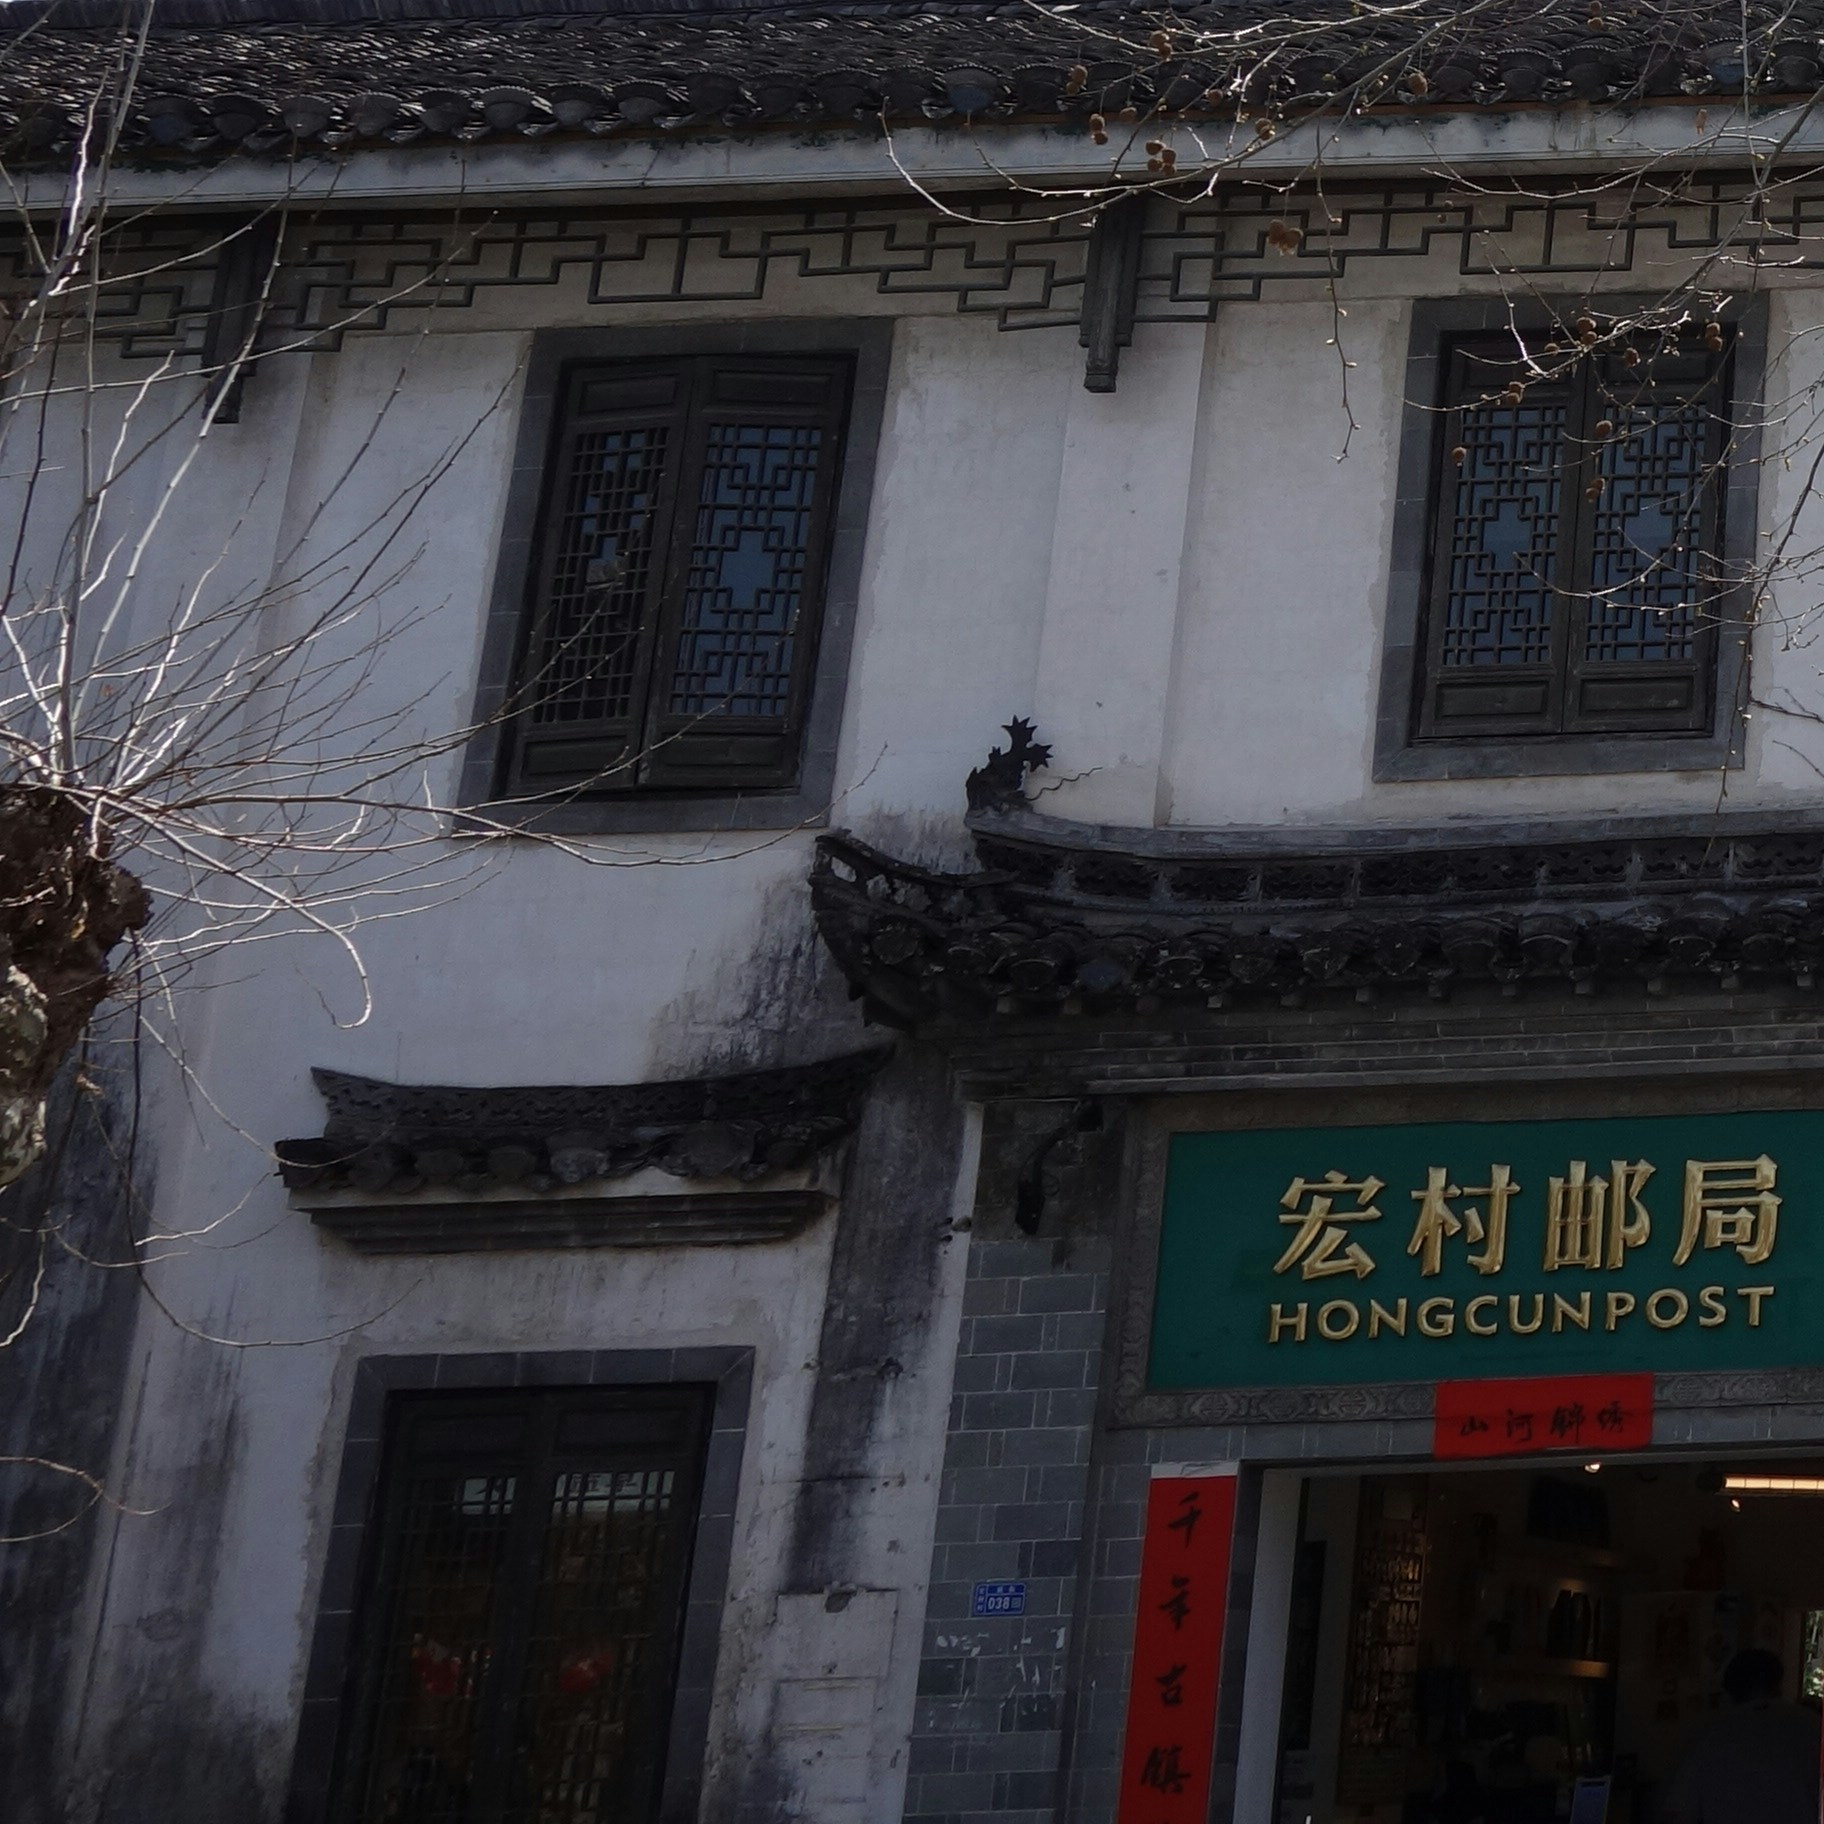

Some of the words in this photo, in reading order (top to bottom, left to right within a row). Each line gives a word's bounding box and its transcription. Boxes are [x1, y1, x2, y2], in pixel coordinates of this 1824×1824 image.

[1272, 1152, 1783, 1282] 宏村邮局
[1267, 1285, 1777, 1345] HONGCUNPOST
[987, 1596, 1011, 1610] 038
